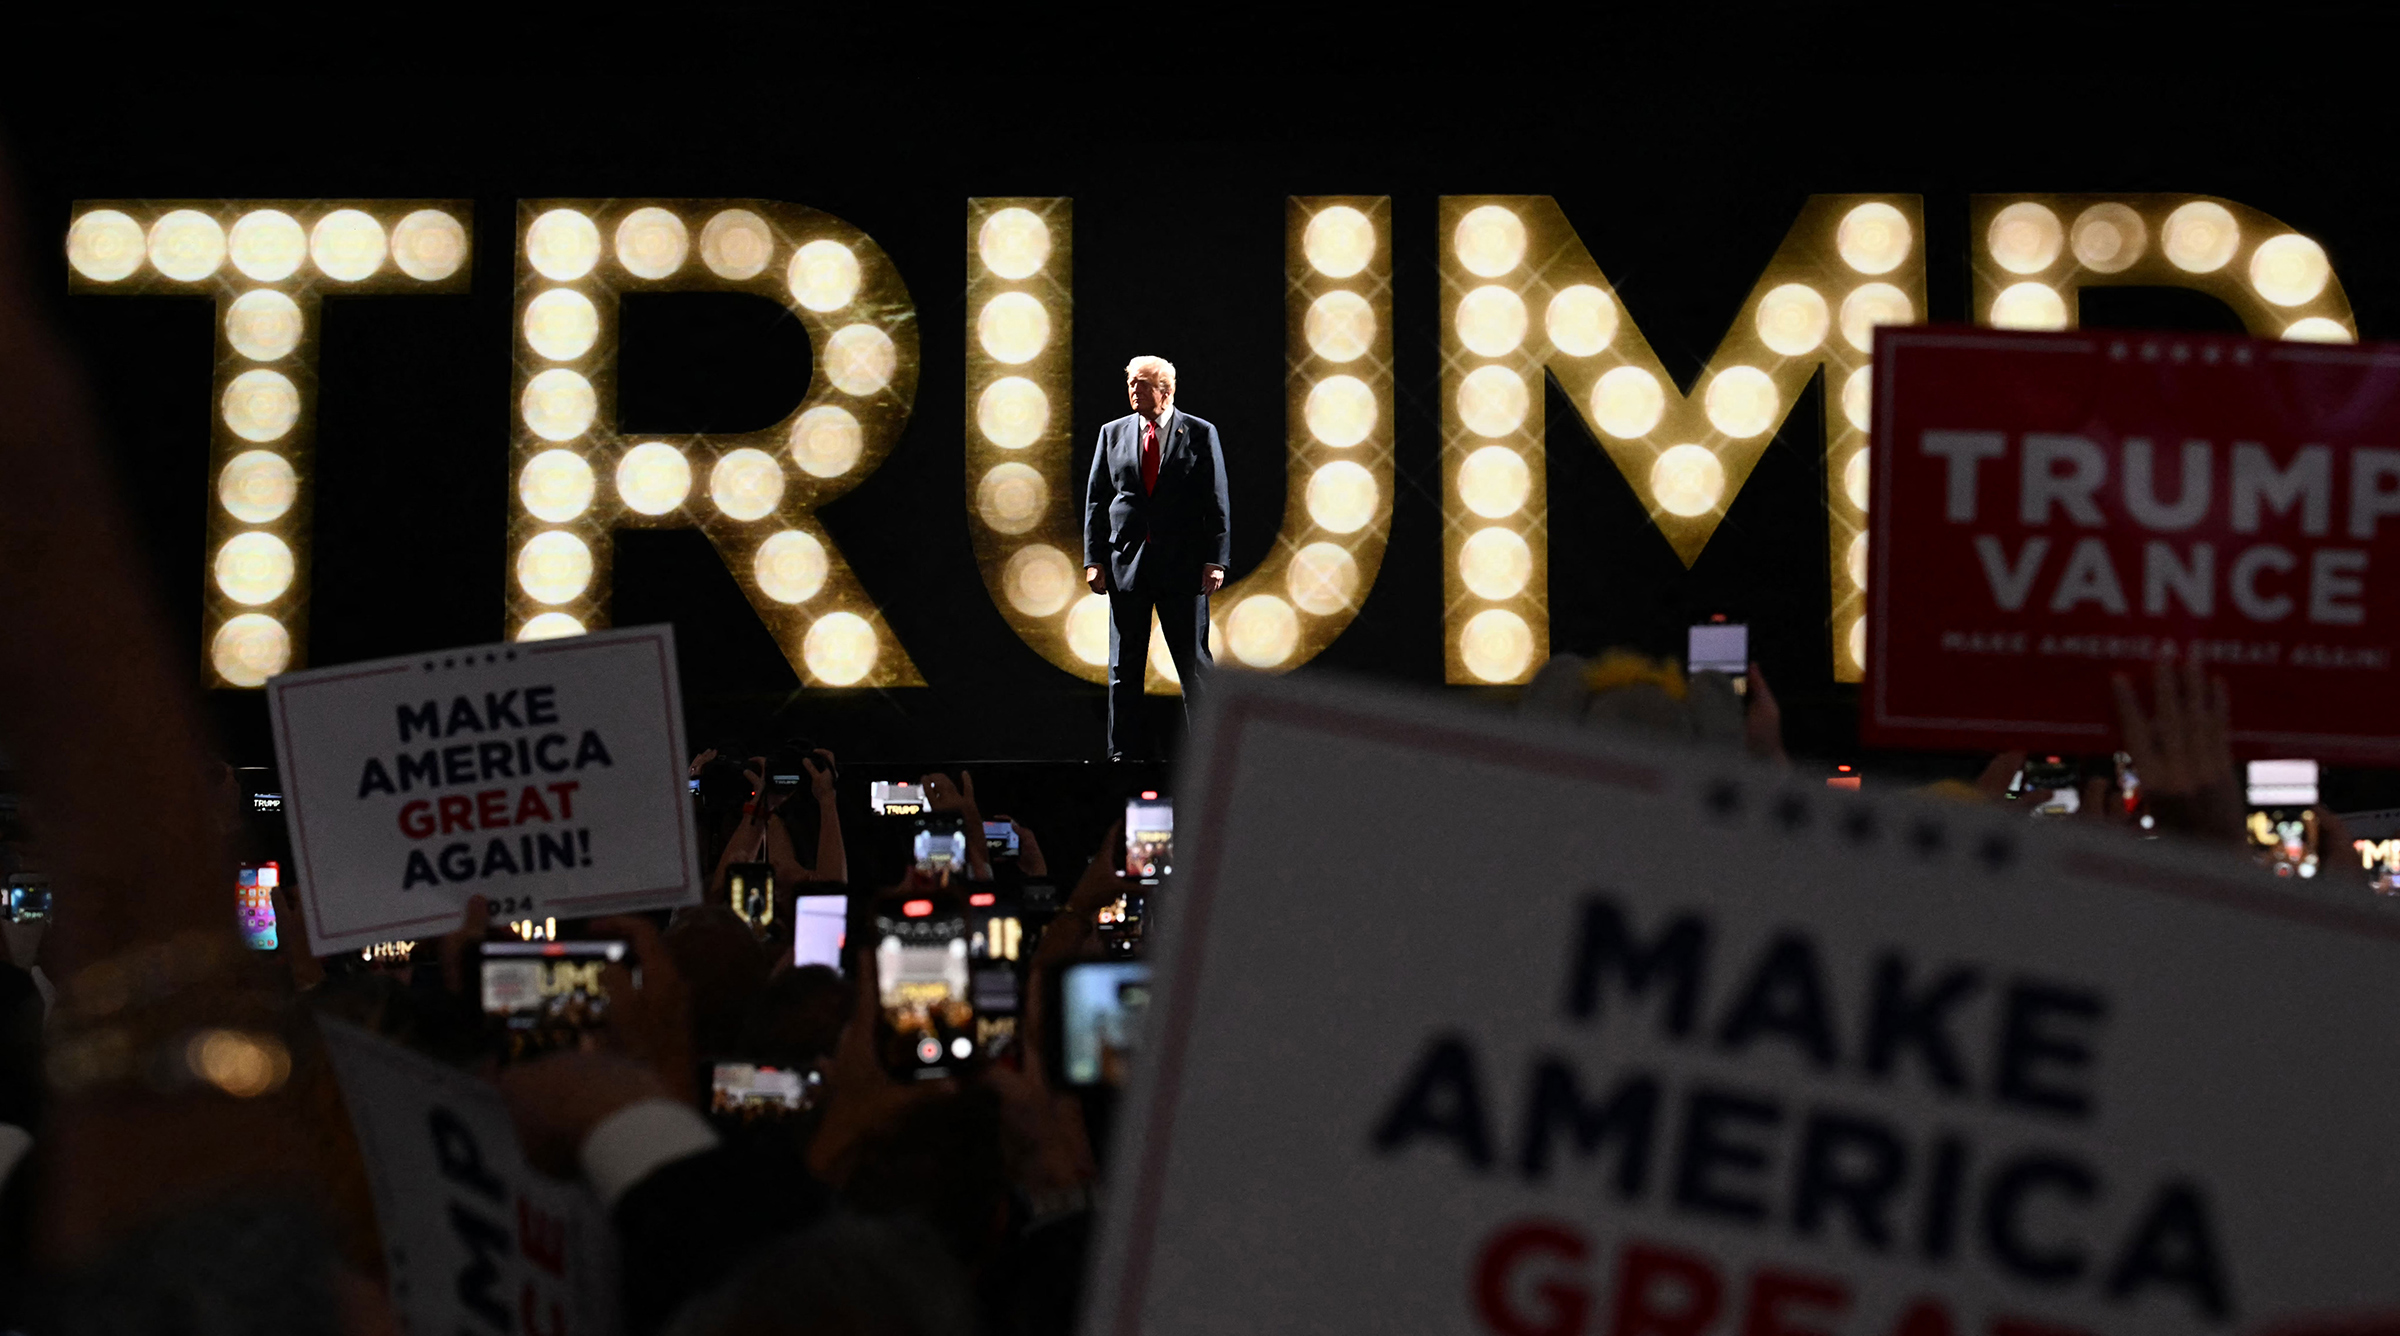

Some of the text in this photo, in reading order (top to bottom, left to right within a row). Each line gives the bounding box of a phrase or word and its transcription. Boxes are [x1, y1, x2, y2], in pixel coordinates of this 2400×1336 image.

[1918, 427, 2400, 541] TRUMP
[1972, 532, 2373, 627] VANCE
[397, 685, 559, 743] MAKE
[358, 729, 612, 799] AMERICA
[254, 799, 281, 807] TRUMP
[399, 780, 579, 840] GREAT
[886, 804, 920, 815] TRUMP
[403, 829, 593, 890] AGAIN!
[487, 895, 533, 916] 024
[1565, 886, 2110, 1122] MAKE
[1374, 1032, 2238, 1323] AMERICA
